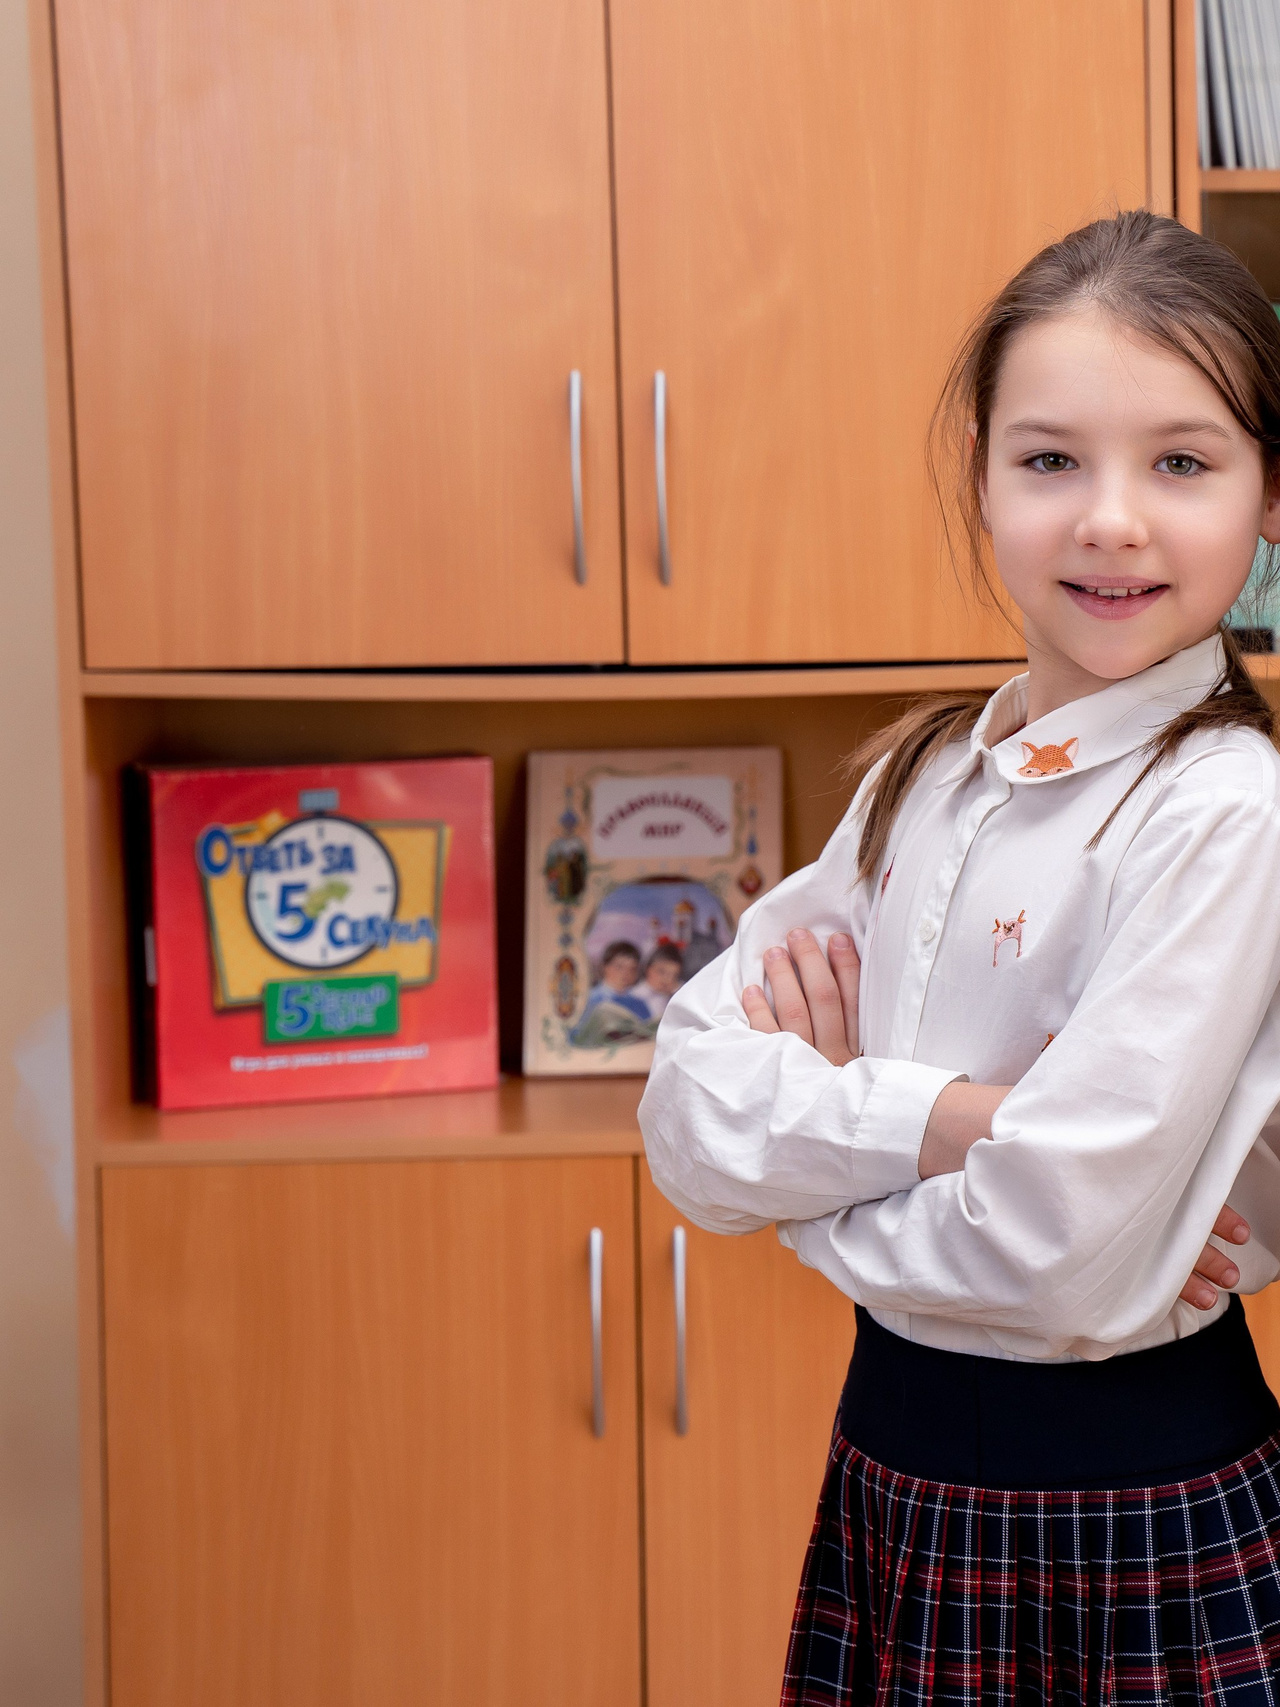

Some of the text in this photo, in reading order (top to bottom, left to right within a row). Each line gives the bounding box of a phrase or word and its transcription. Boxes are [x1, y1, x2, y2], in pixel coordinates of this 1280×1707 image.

[319, 845, 357, 876] ЗА
[275, 883, 316, 943] 5
[276, 984, 313, 1034] 5
